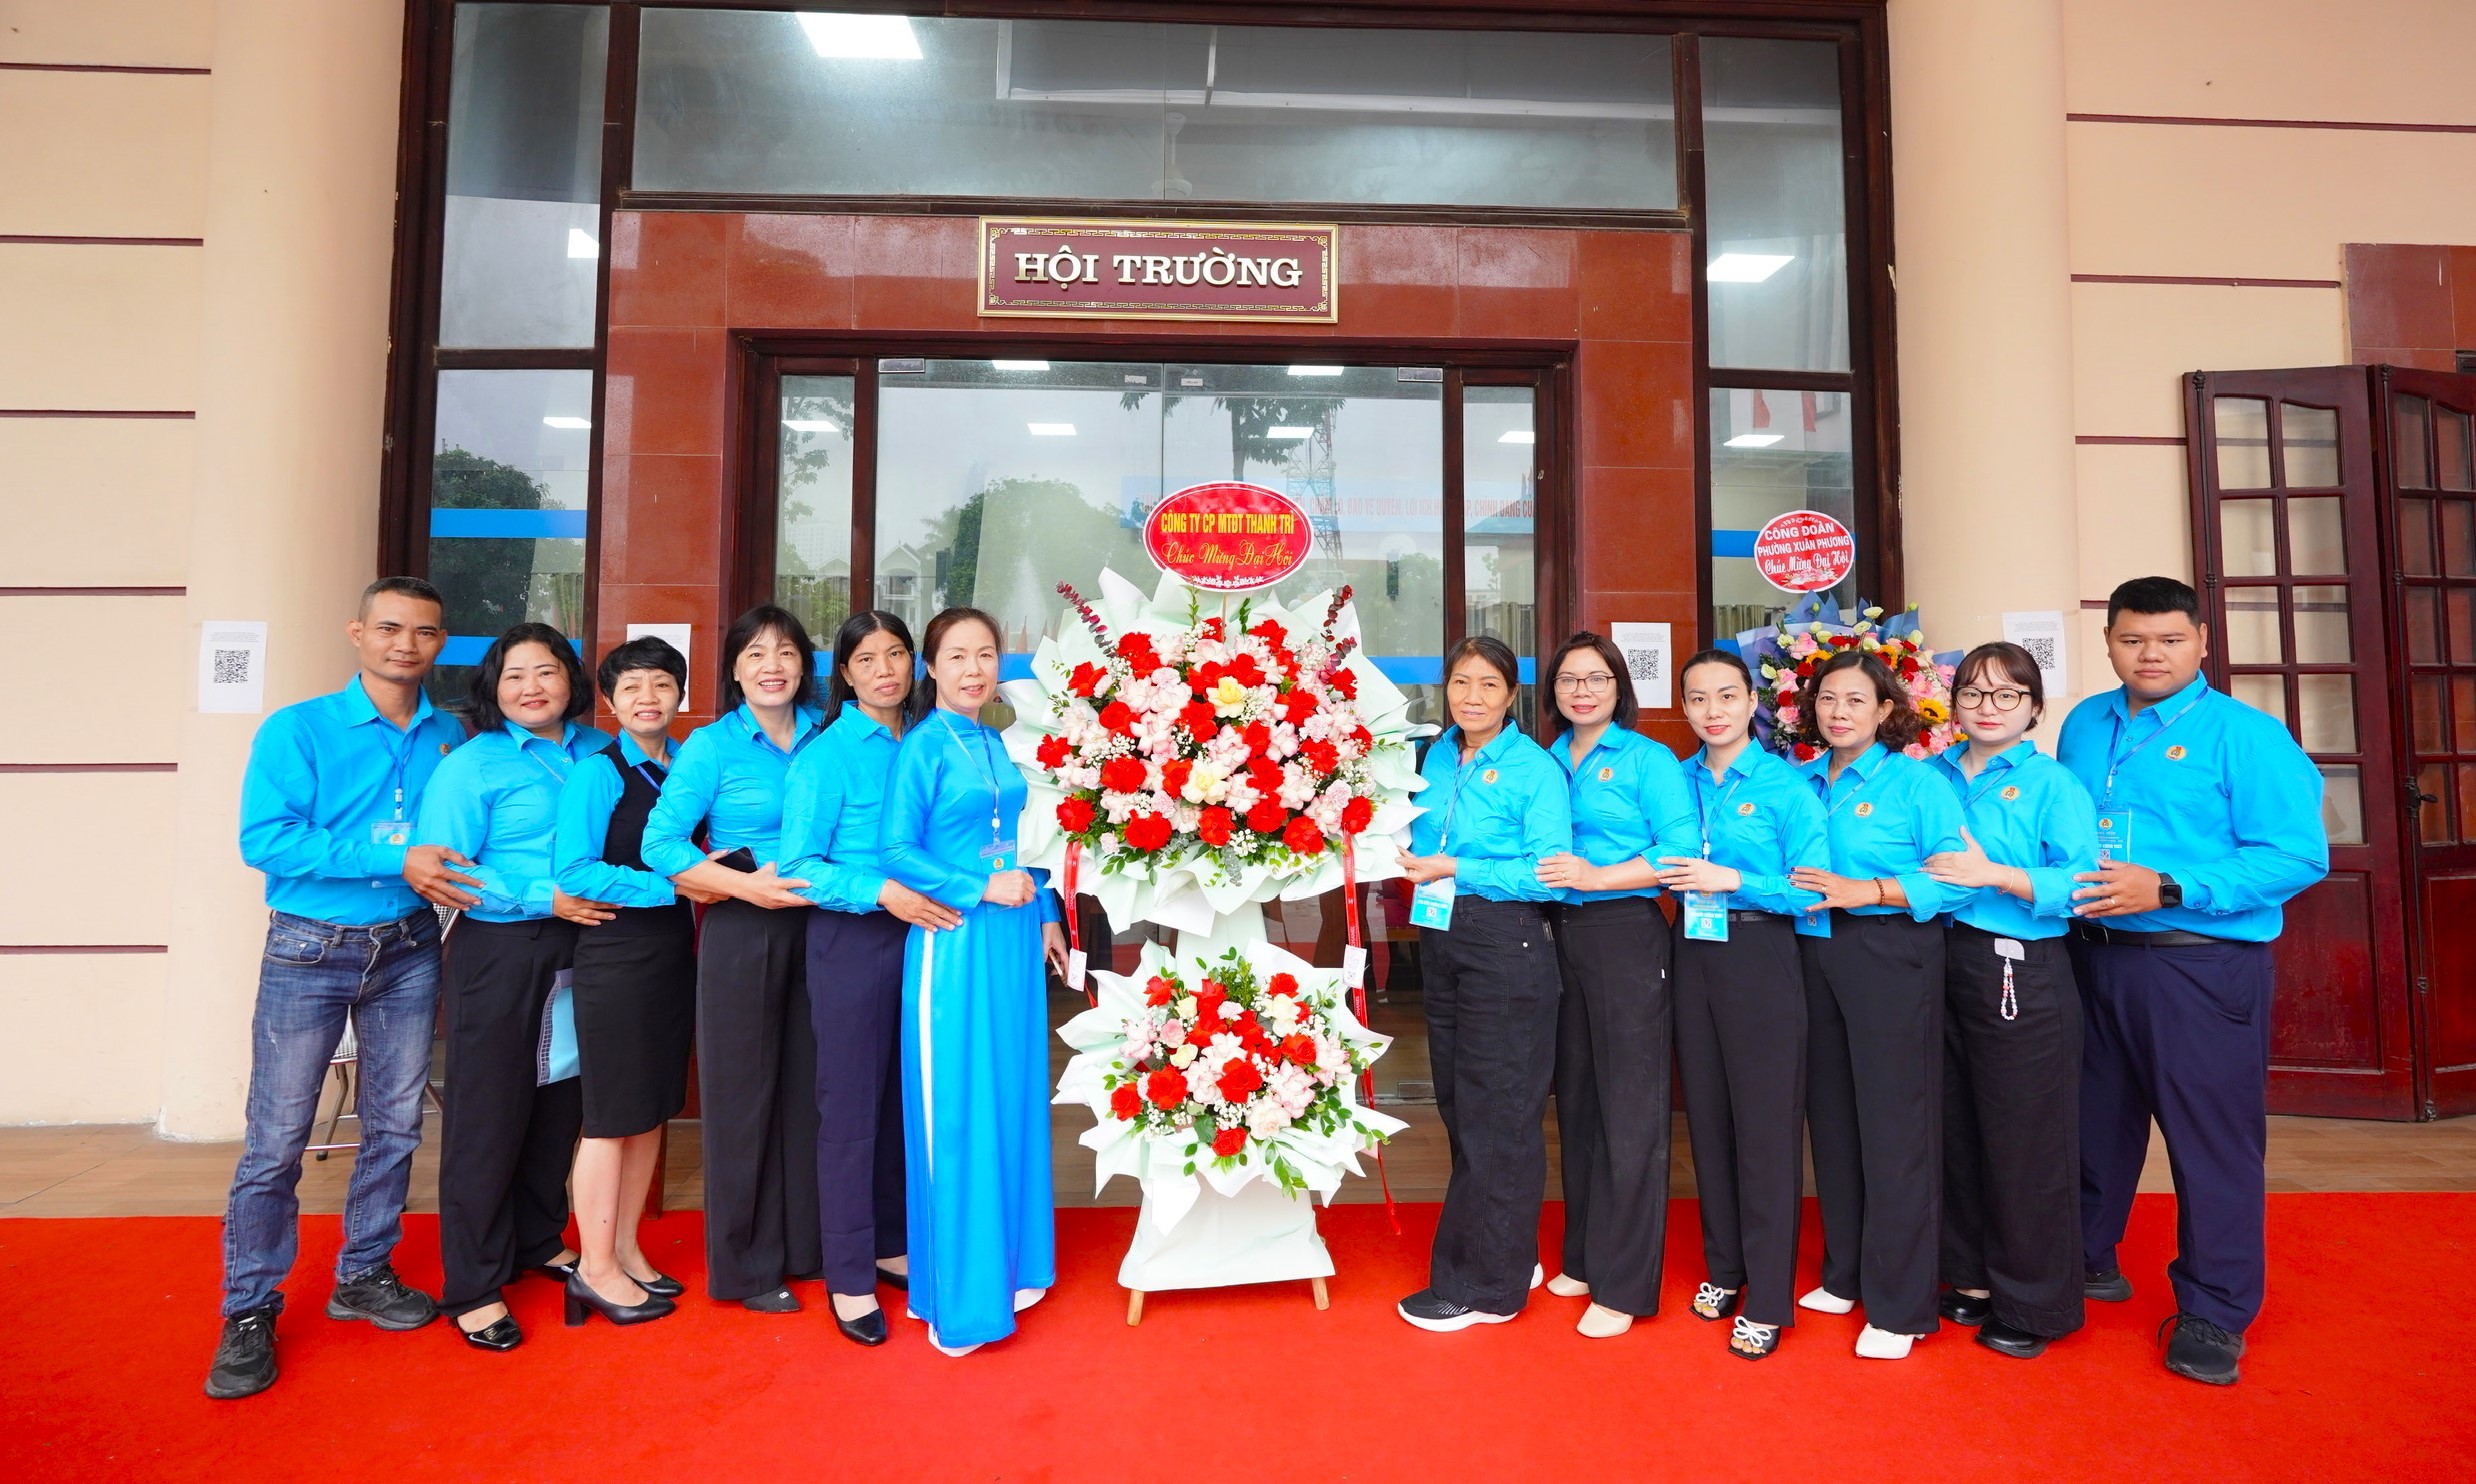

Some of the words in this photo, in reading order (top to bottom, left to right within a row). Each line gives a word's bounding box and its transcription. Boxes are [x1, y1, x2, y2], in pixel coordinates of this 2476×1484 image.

[1014, 245, 1099, 290] HỘI
[1113, 247, 1303, 288] TRƯỜNG
[1161, 509, 1187, 533] CÔNG
[1189, 513, 1200, 533] TY
[1203, 513, 1216, 533] CP
[1218, 513, 1243, 534] MTĐT
[1246, 513, 1277, 534] THANH
[1764, 527, 1799, 541] CÔNG
[1801, 520, 1835, 537] ĐOÀN
[1161, 541, 1195, 564] Chúc
[1199, 542, 1236, 571] Mừng
[1235, 539, 1264, 569] Đại
[1264, 542, 1293, 570] Hội
[1757, 542, 1792, 558] PHƯỜNG
[1793, 538, 1816, 552] XUÂN
[1817, 535, 1851, 549] PHƯƠNG
[1764, 559, 1786, 575] Chúc
[1786, 556, 1812, 572] Mừng
[1831, 550, 1850, 569] Hội
